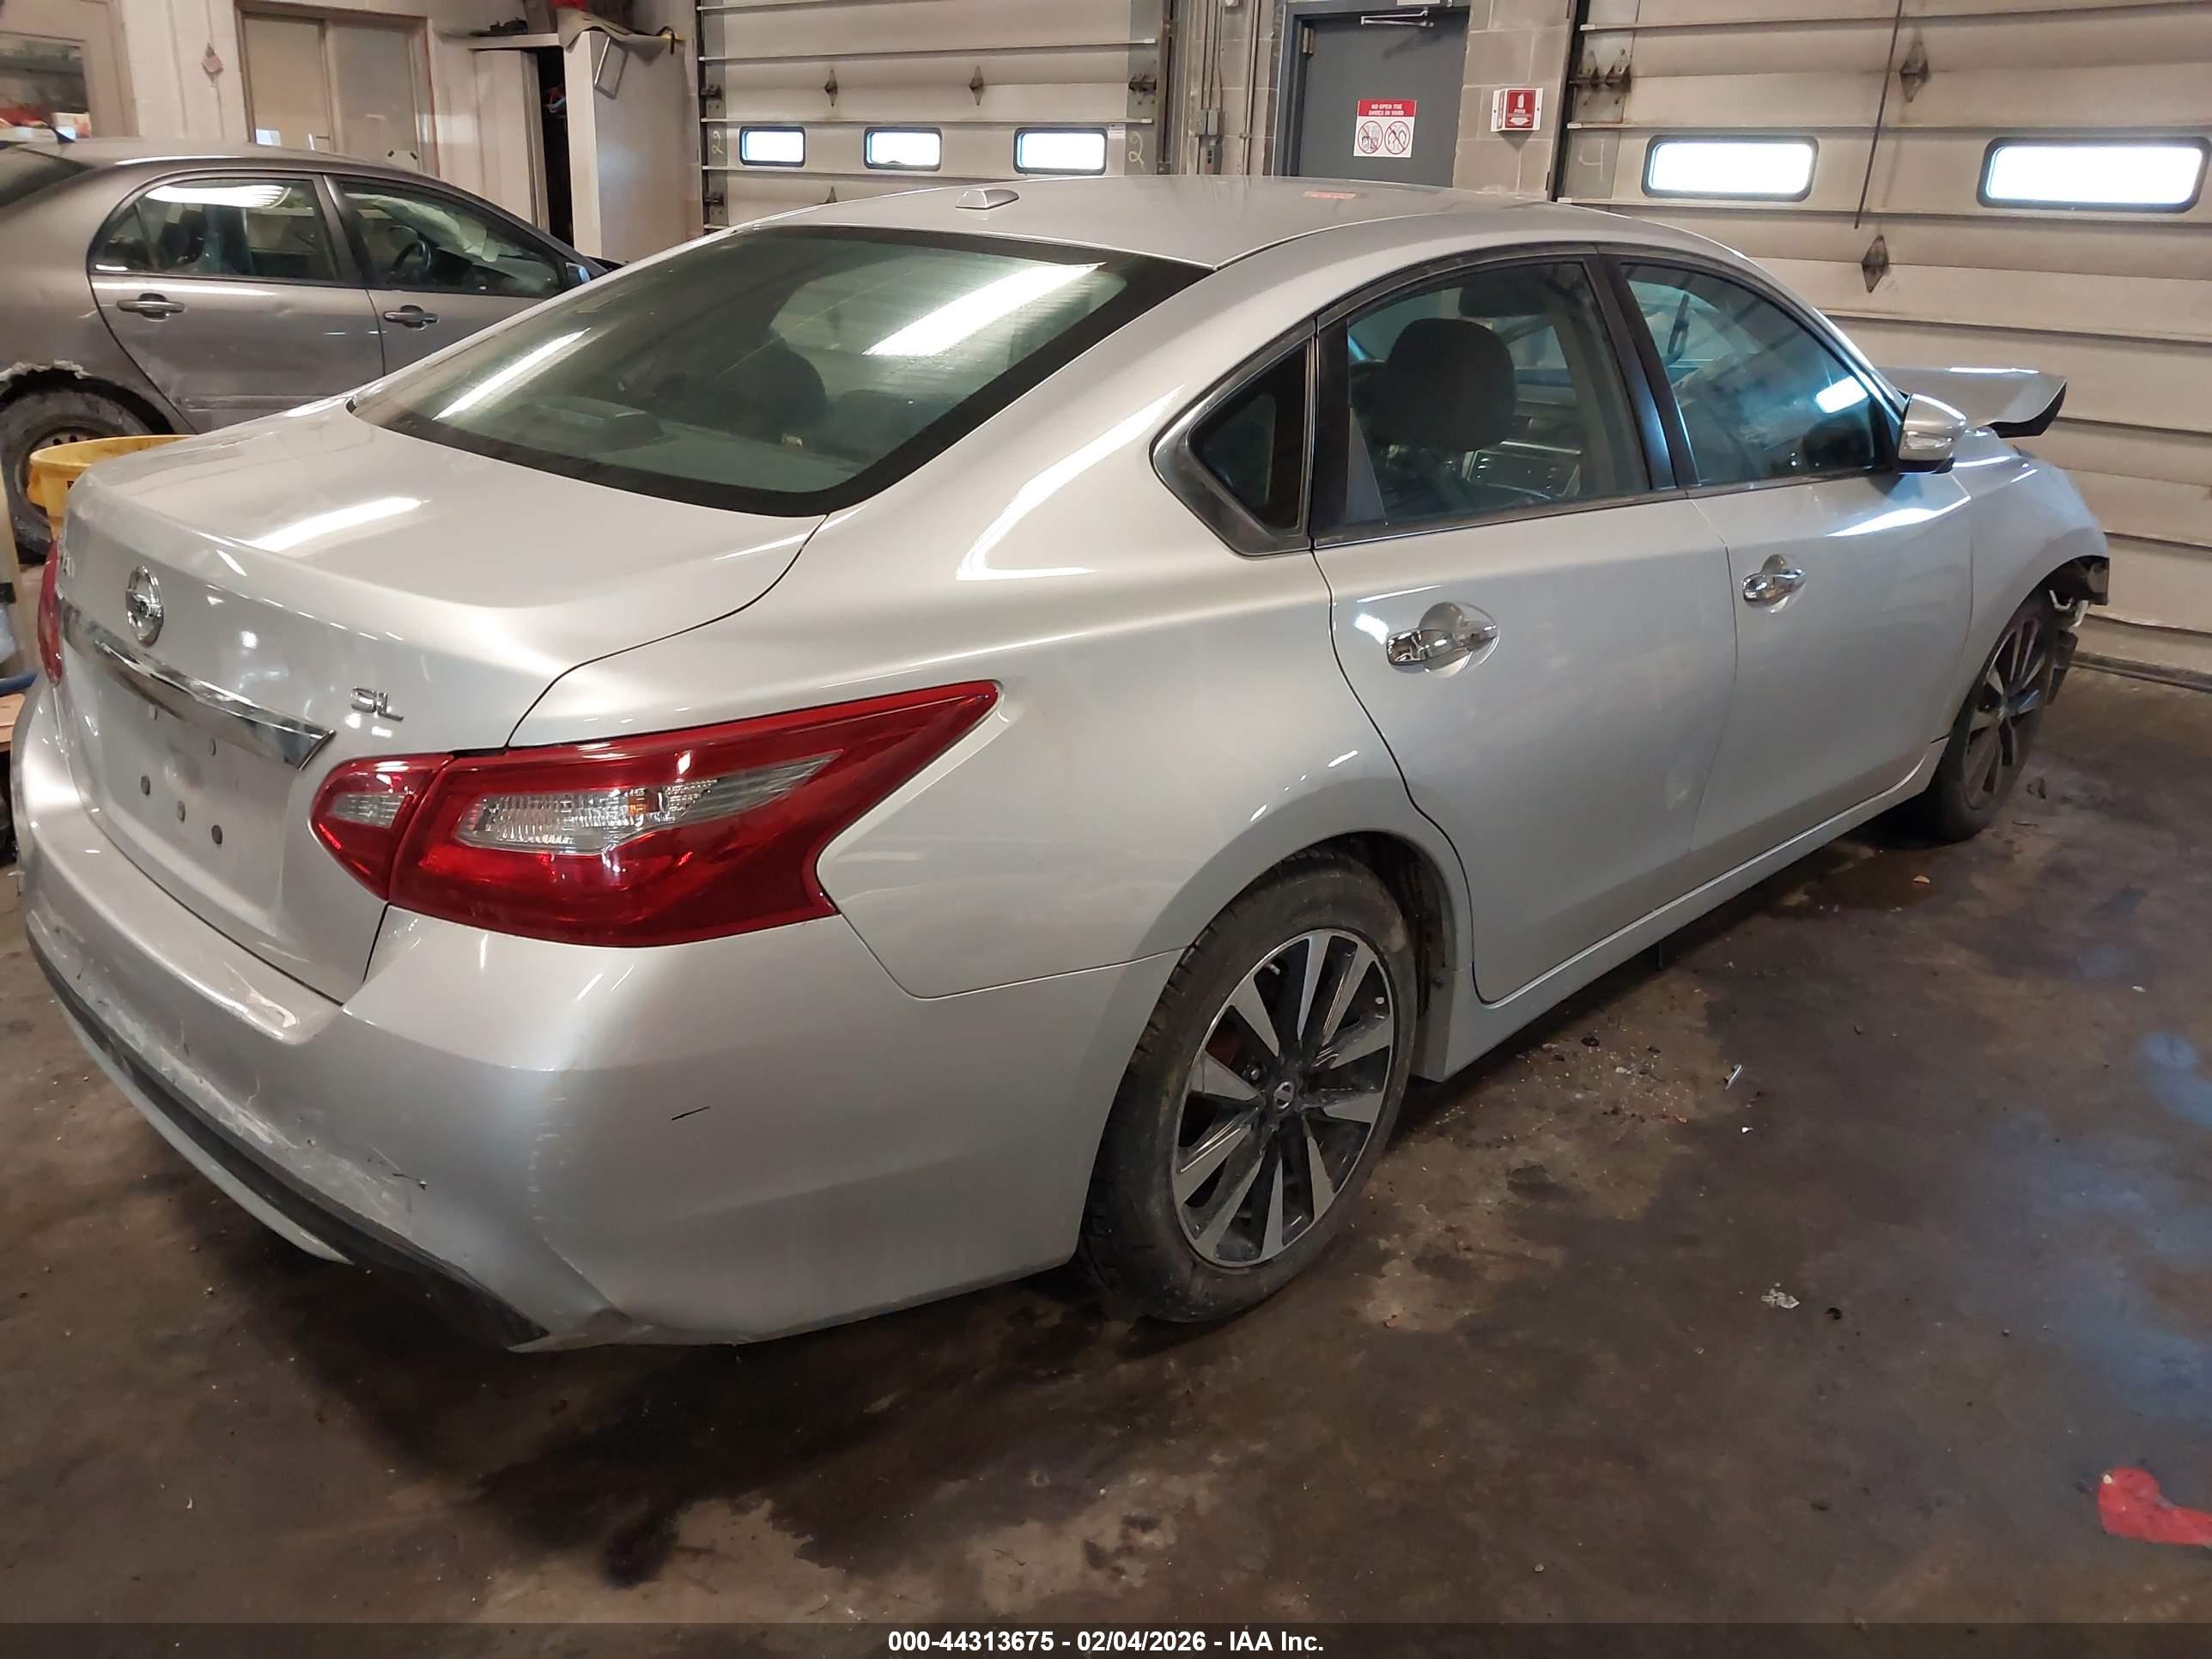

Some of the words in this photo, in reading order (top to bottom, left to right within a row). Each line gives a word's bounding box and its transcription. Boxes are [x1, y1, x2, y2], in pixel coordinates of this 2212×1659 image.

[1128, 131, 1146, 167] 2
[1579, 138, 1604, 180] 4
[349, 686, 406, 722] SL
